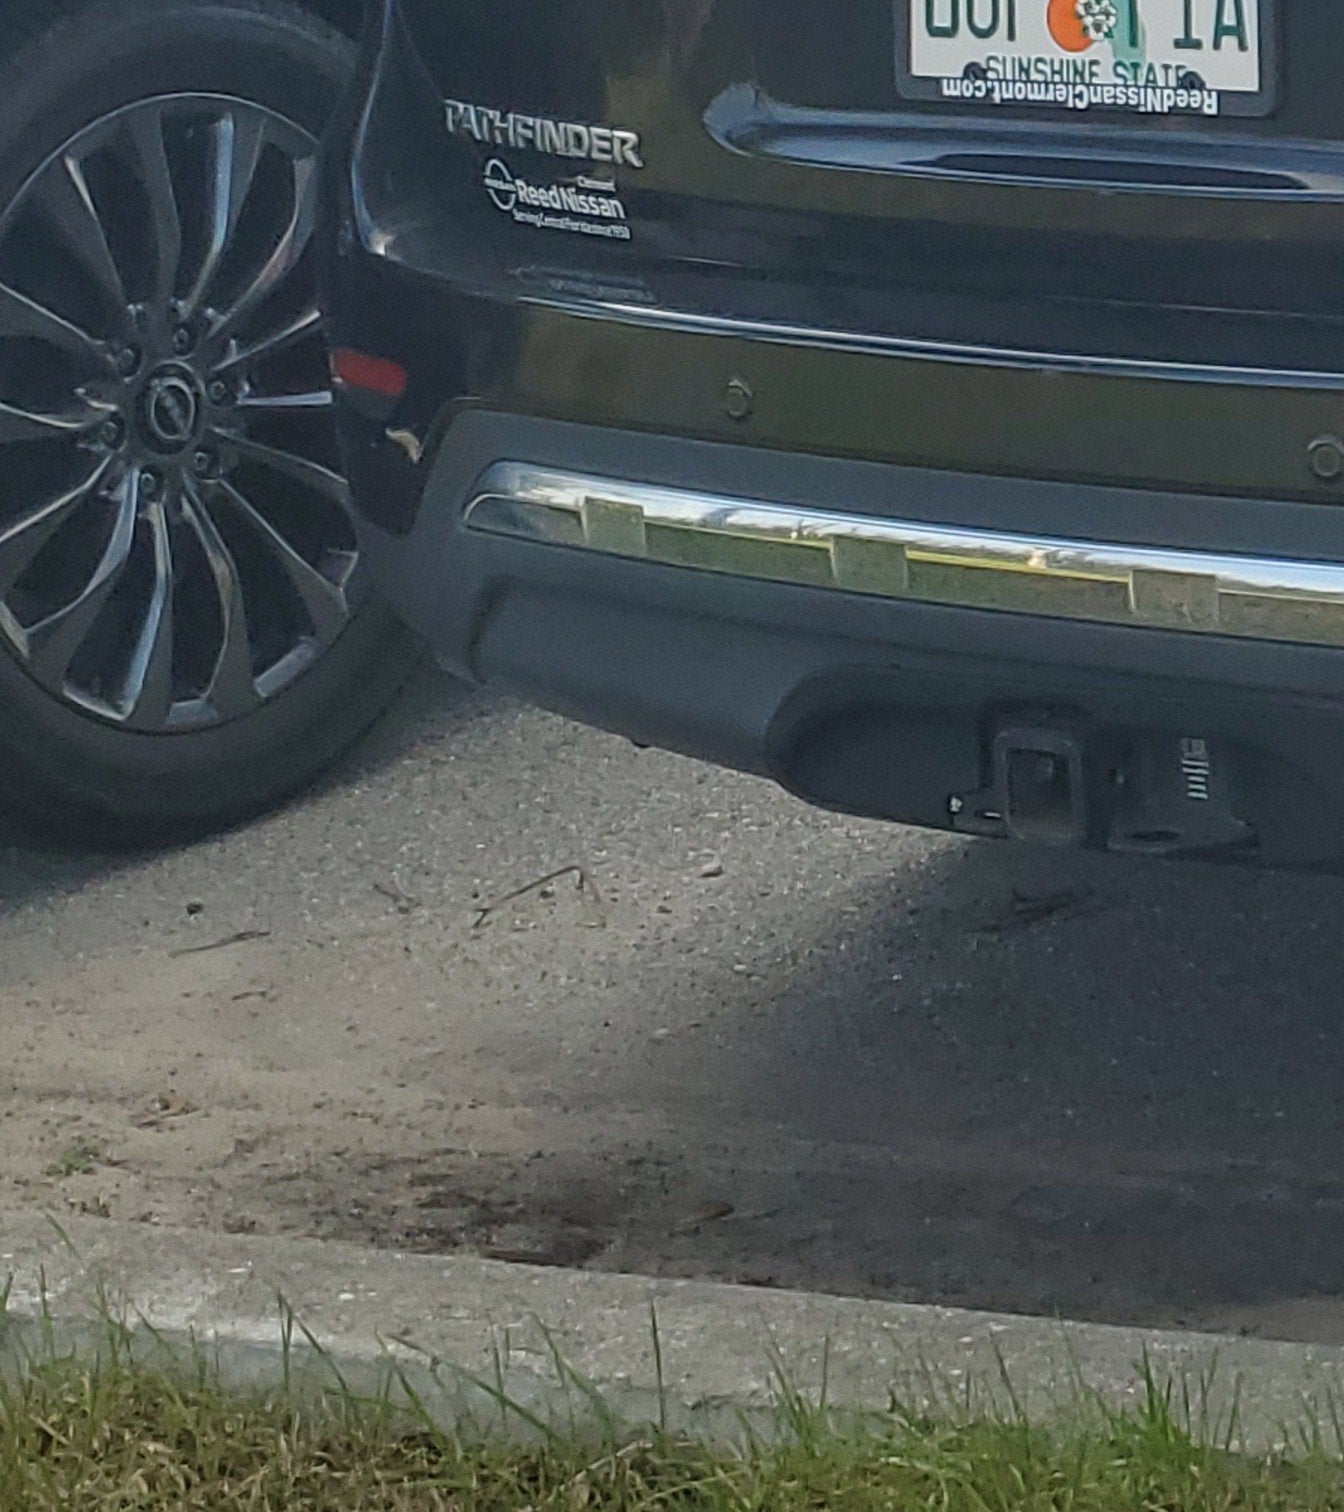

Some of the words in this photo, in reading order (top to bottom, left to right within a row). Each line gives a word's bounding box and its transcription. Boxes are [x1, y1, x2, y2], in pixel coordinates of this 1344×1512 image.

[985, 54, 1102, 84] SUNSHINE
[942, 78, 1219, 115] ReedNissanClermont.com
[444, 99, 645, 169] PATHFINDER
